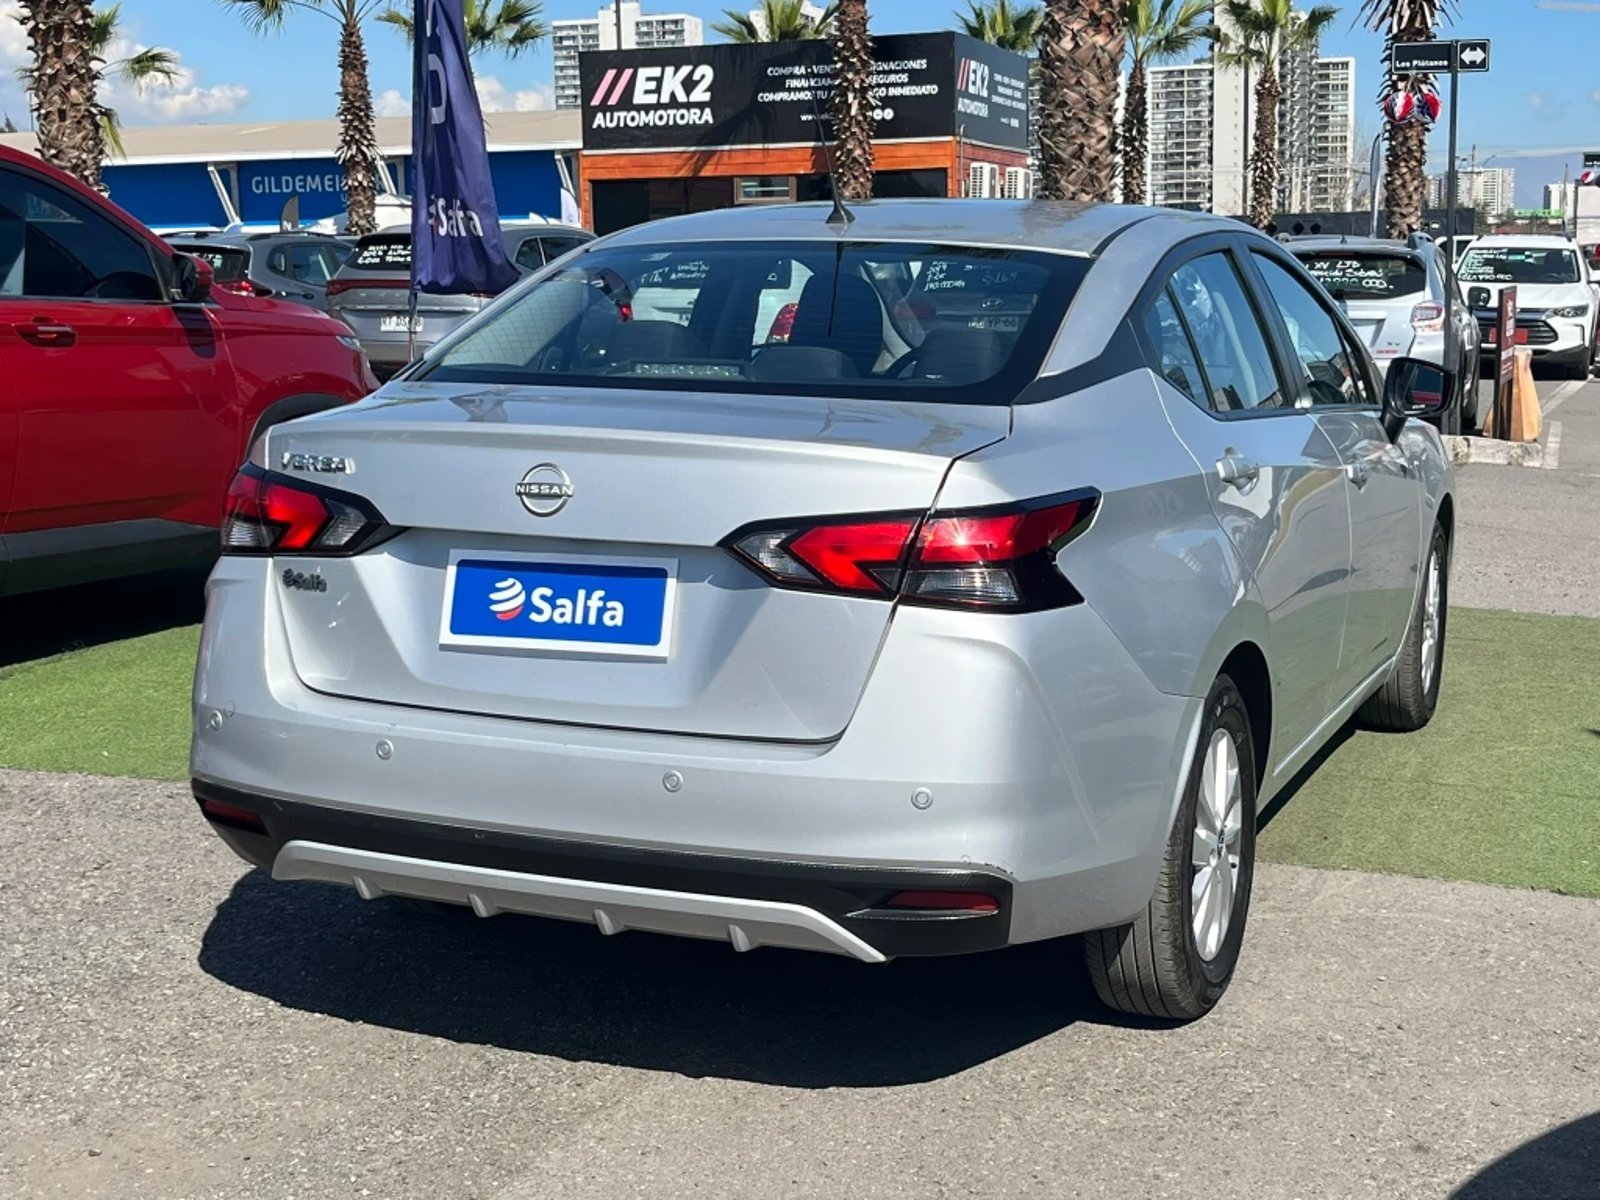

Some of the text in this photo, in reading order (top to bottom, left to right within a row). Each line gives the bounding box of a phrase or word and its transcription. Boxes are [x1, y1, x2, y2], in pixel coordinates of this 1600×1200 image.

[767, 65, 806, 76] COMPRA
[816, 91, 828, 99] TU
[888, 85, 938, 97] INMEDIATO
[592, 108, 713, 129] AUTOMOTORA
[251, 174, 346, 194] GILDEMEI
[437, 197, 484, 237] Salfa
[281, 452, 354, 474] VERSA
[515, 483, 573, 496] NISSAN
[529, 586, 625, 628] Salfa
